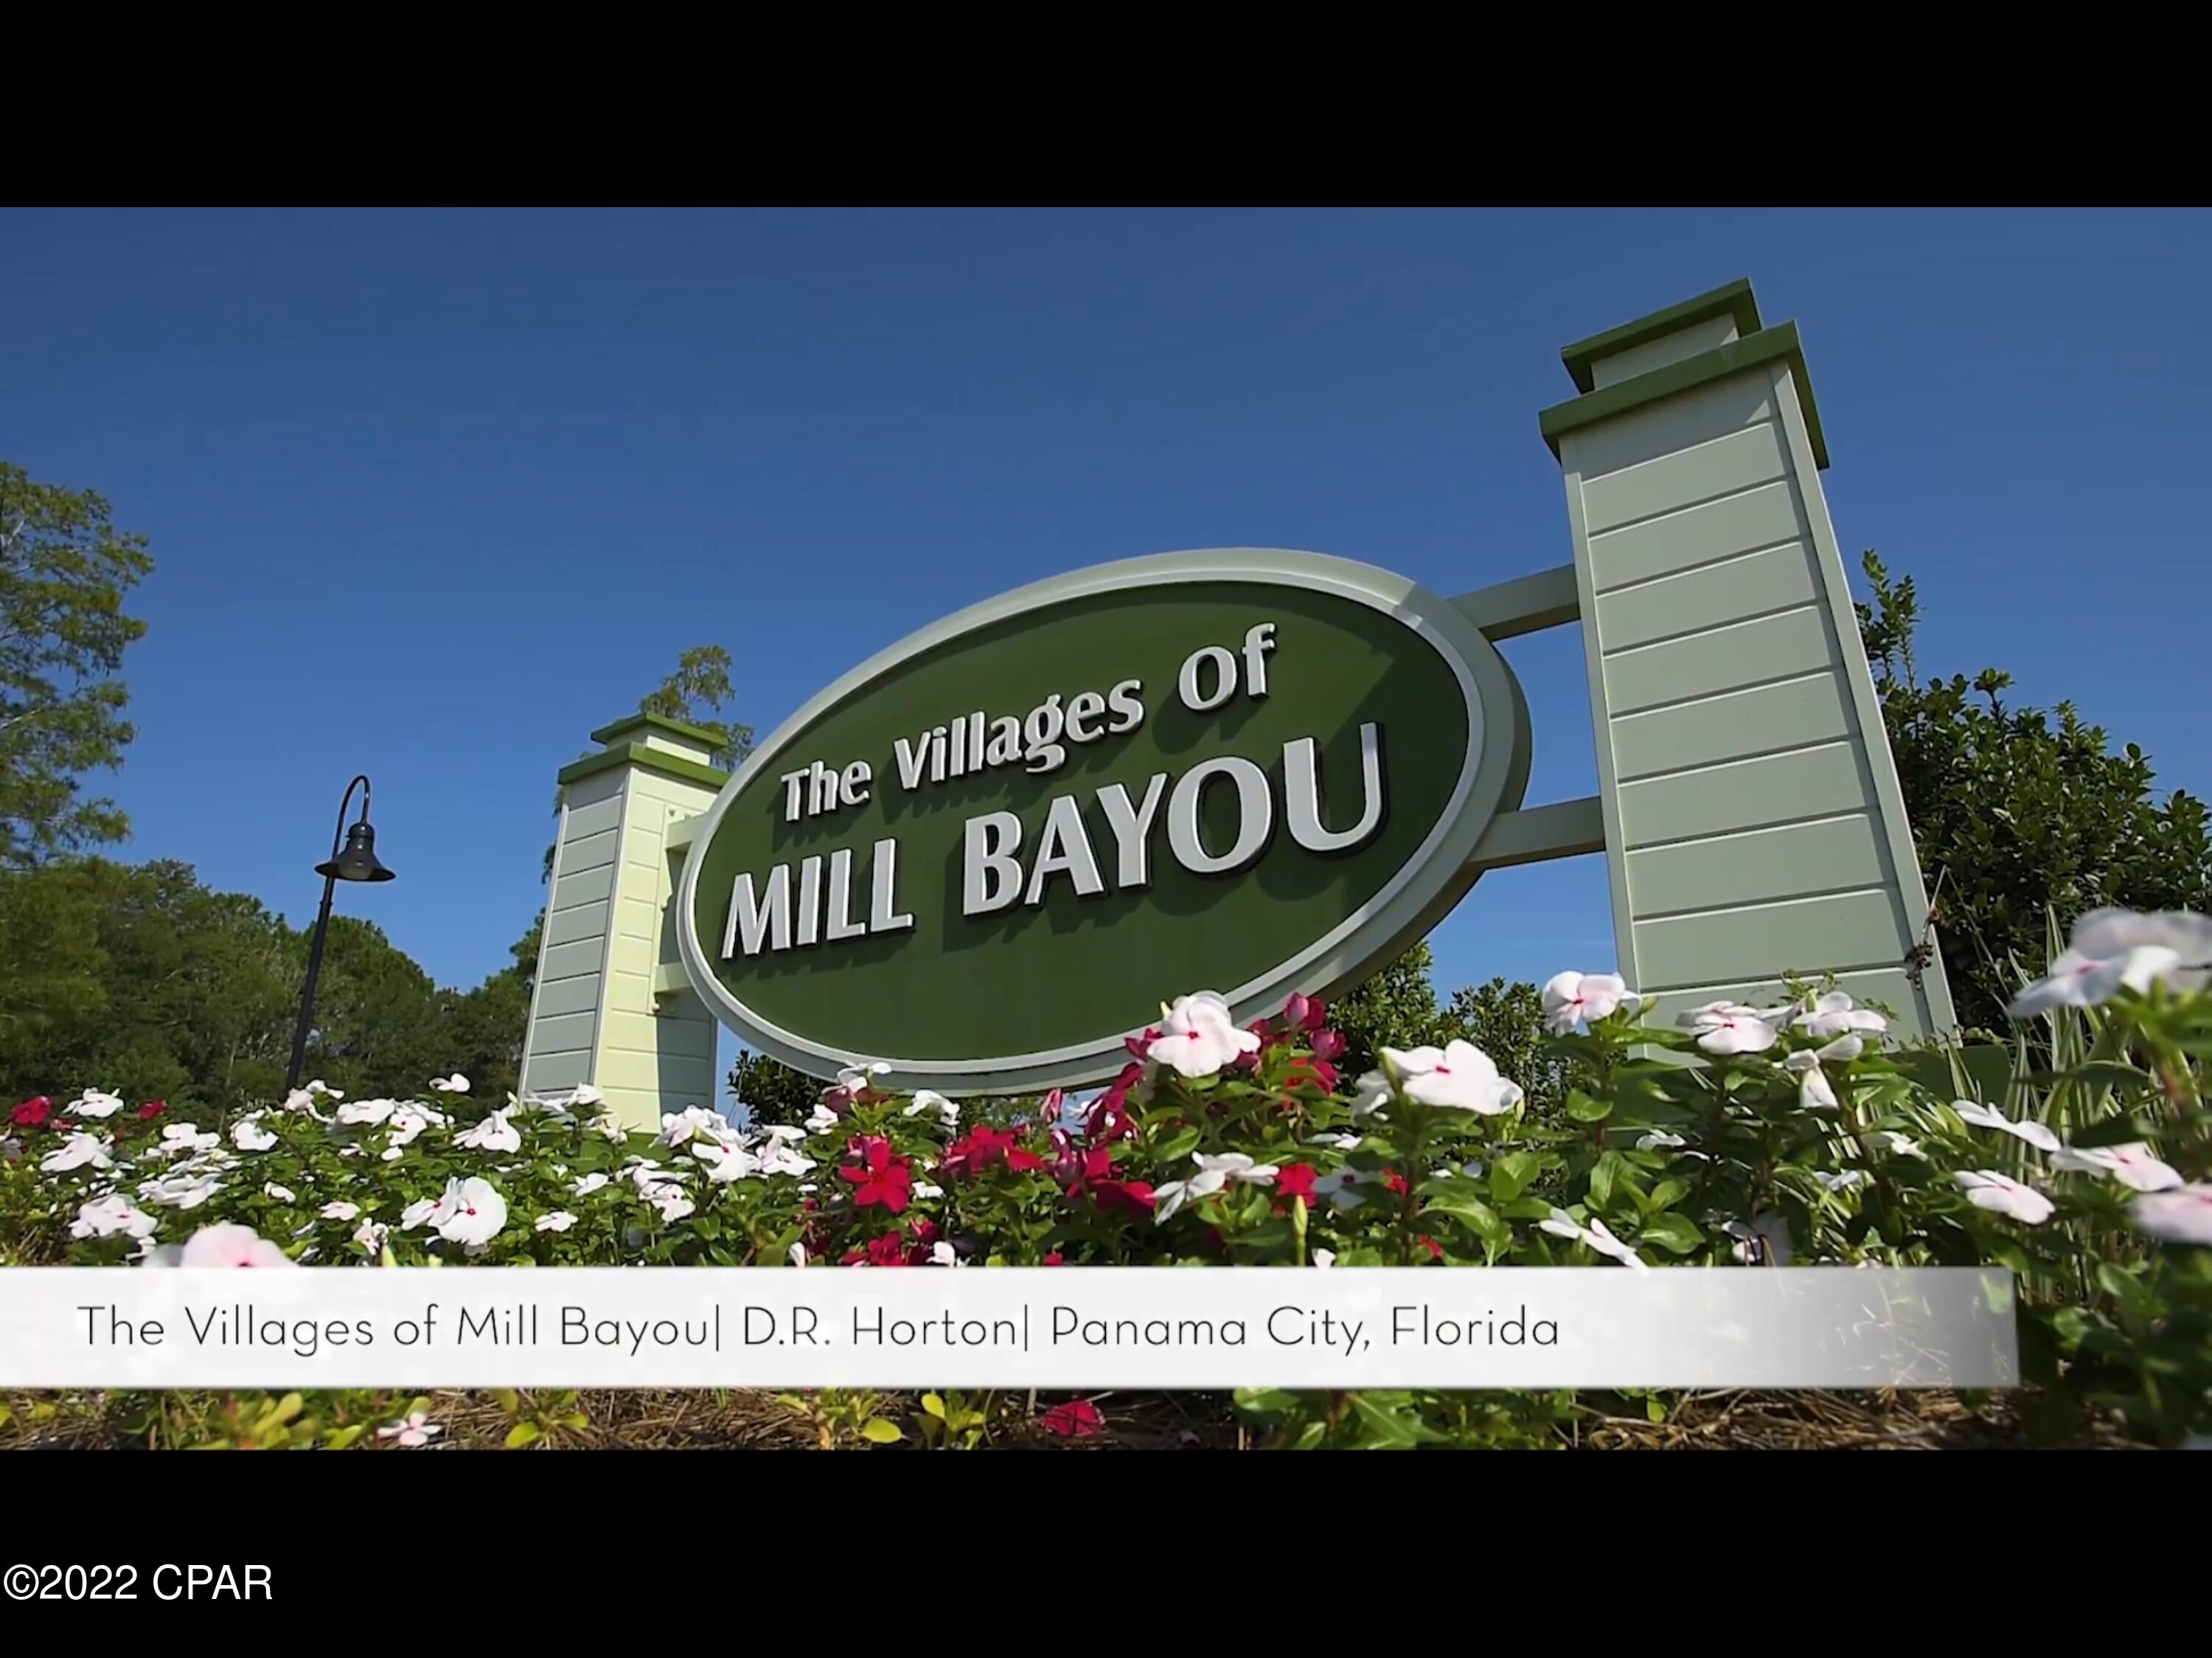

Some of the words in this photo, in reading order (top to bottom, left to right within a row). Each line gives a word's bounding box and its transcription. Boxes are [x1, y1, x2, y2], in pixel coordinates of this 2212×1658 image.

[782, 759, 872, 822] The
[893, 679, 1145, 774] Villages
[1178, 622, 1278, 712] Of
[720, 837, 915, 960] MILL
[961, 721, 1385, 917] BAYOU
